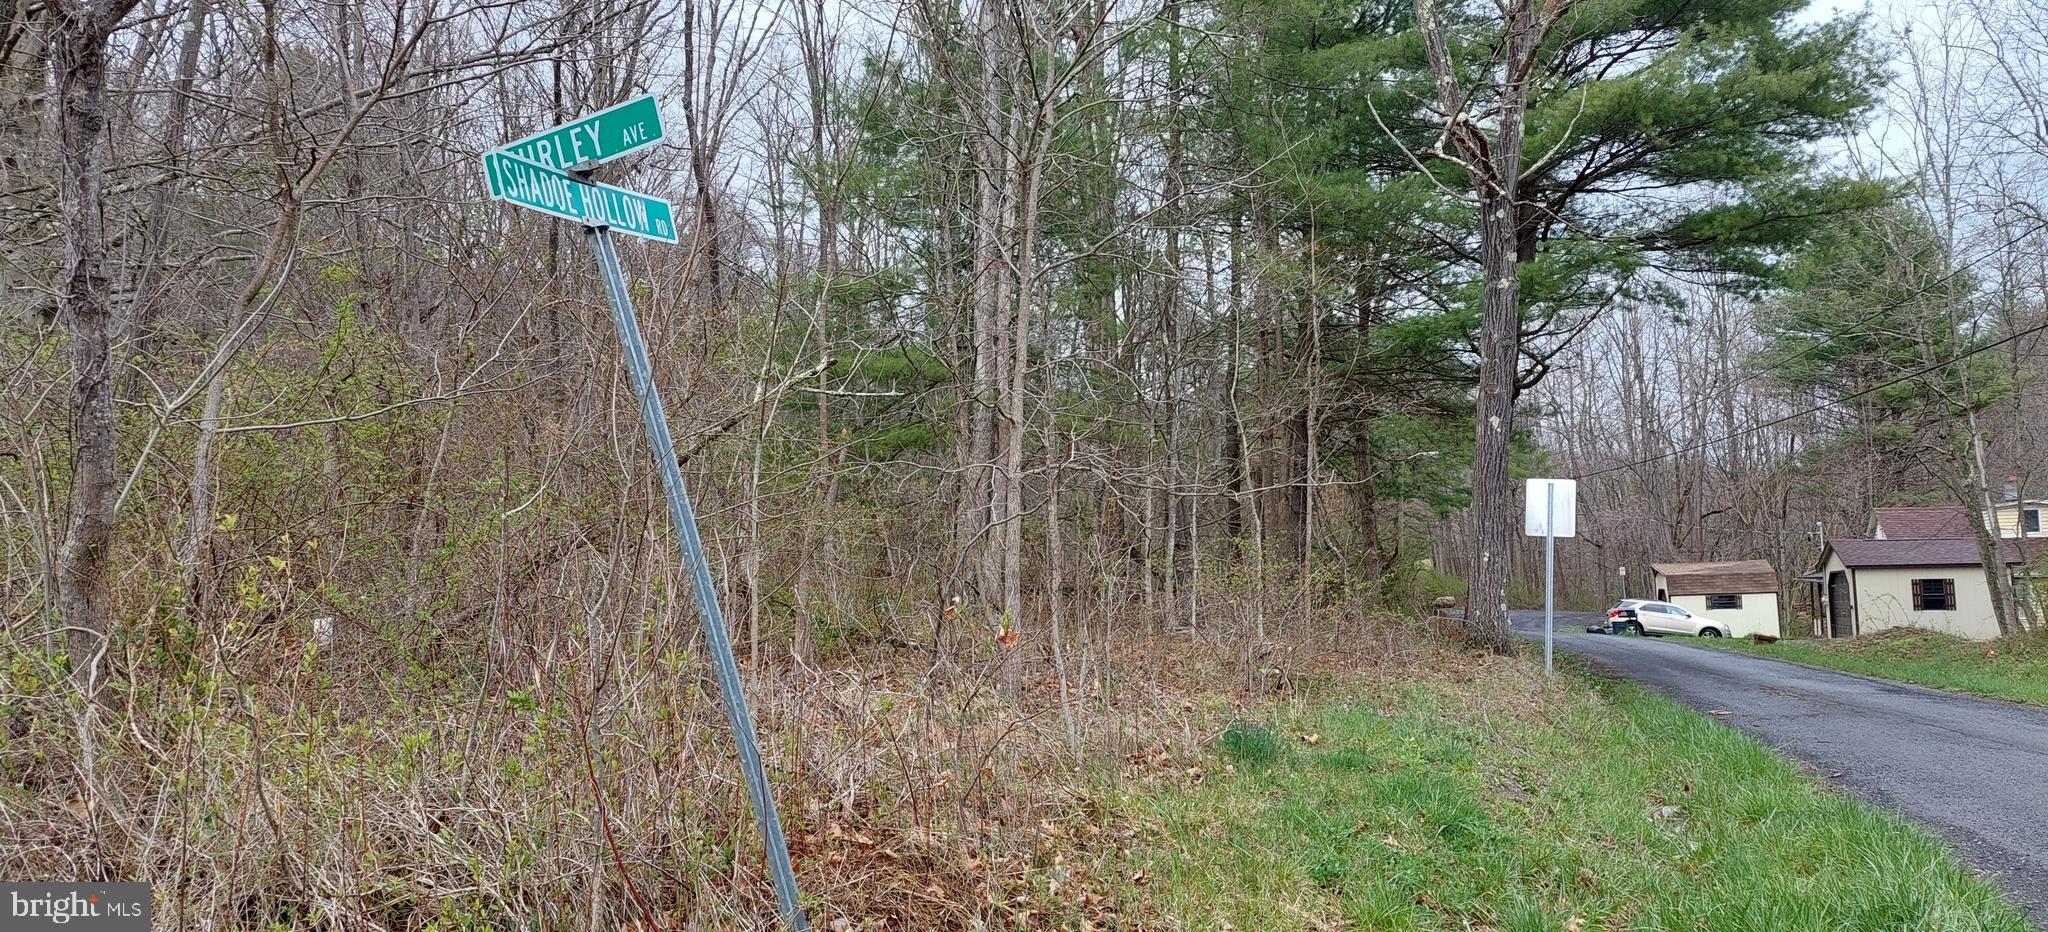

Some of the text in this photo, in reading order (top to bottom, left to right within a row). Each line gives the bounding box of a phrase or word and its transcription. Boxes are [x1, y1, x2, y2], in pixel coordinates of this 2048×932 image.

[623, 121, 648, 147] AVE
[502, 158, 669, 237] SHADOE HOLLOW RD
